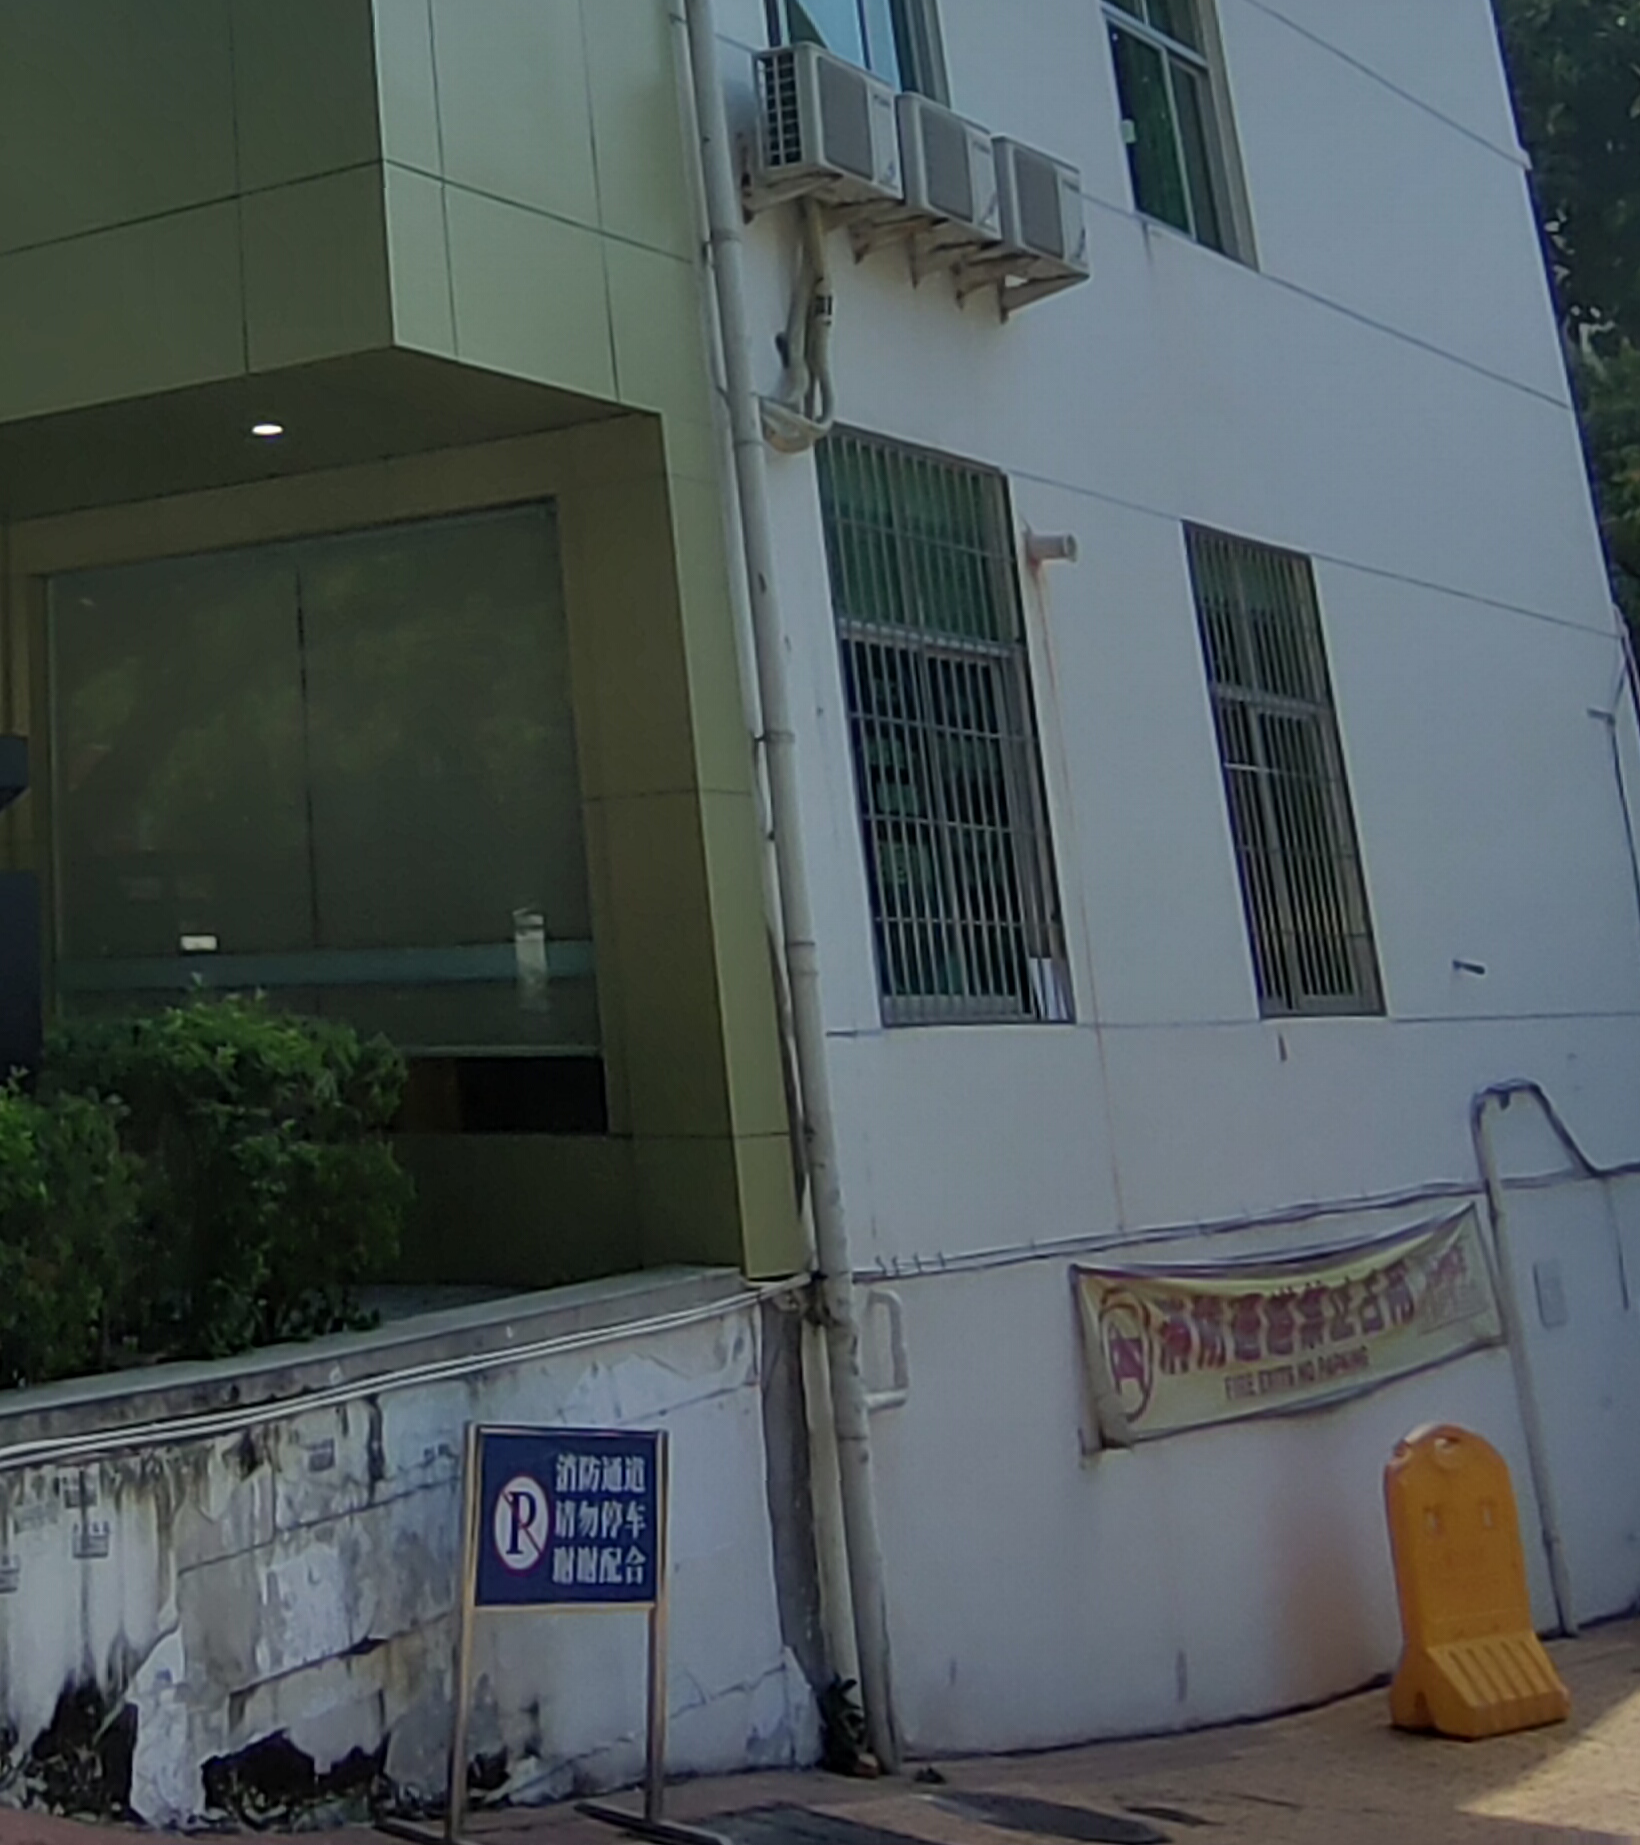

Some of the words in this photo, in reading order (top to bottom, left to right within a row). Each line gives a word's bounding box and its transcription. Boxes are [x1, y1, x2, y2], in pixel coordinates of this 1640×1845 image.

[555, 1453, 646, 1494] 消防通道
[555, 1499, 647, 1539] 请勿停车
[551, 1544, 647, 1585] 谢谢配合
